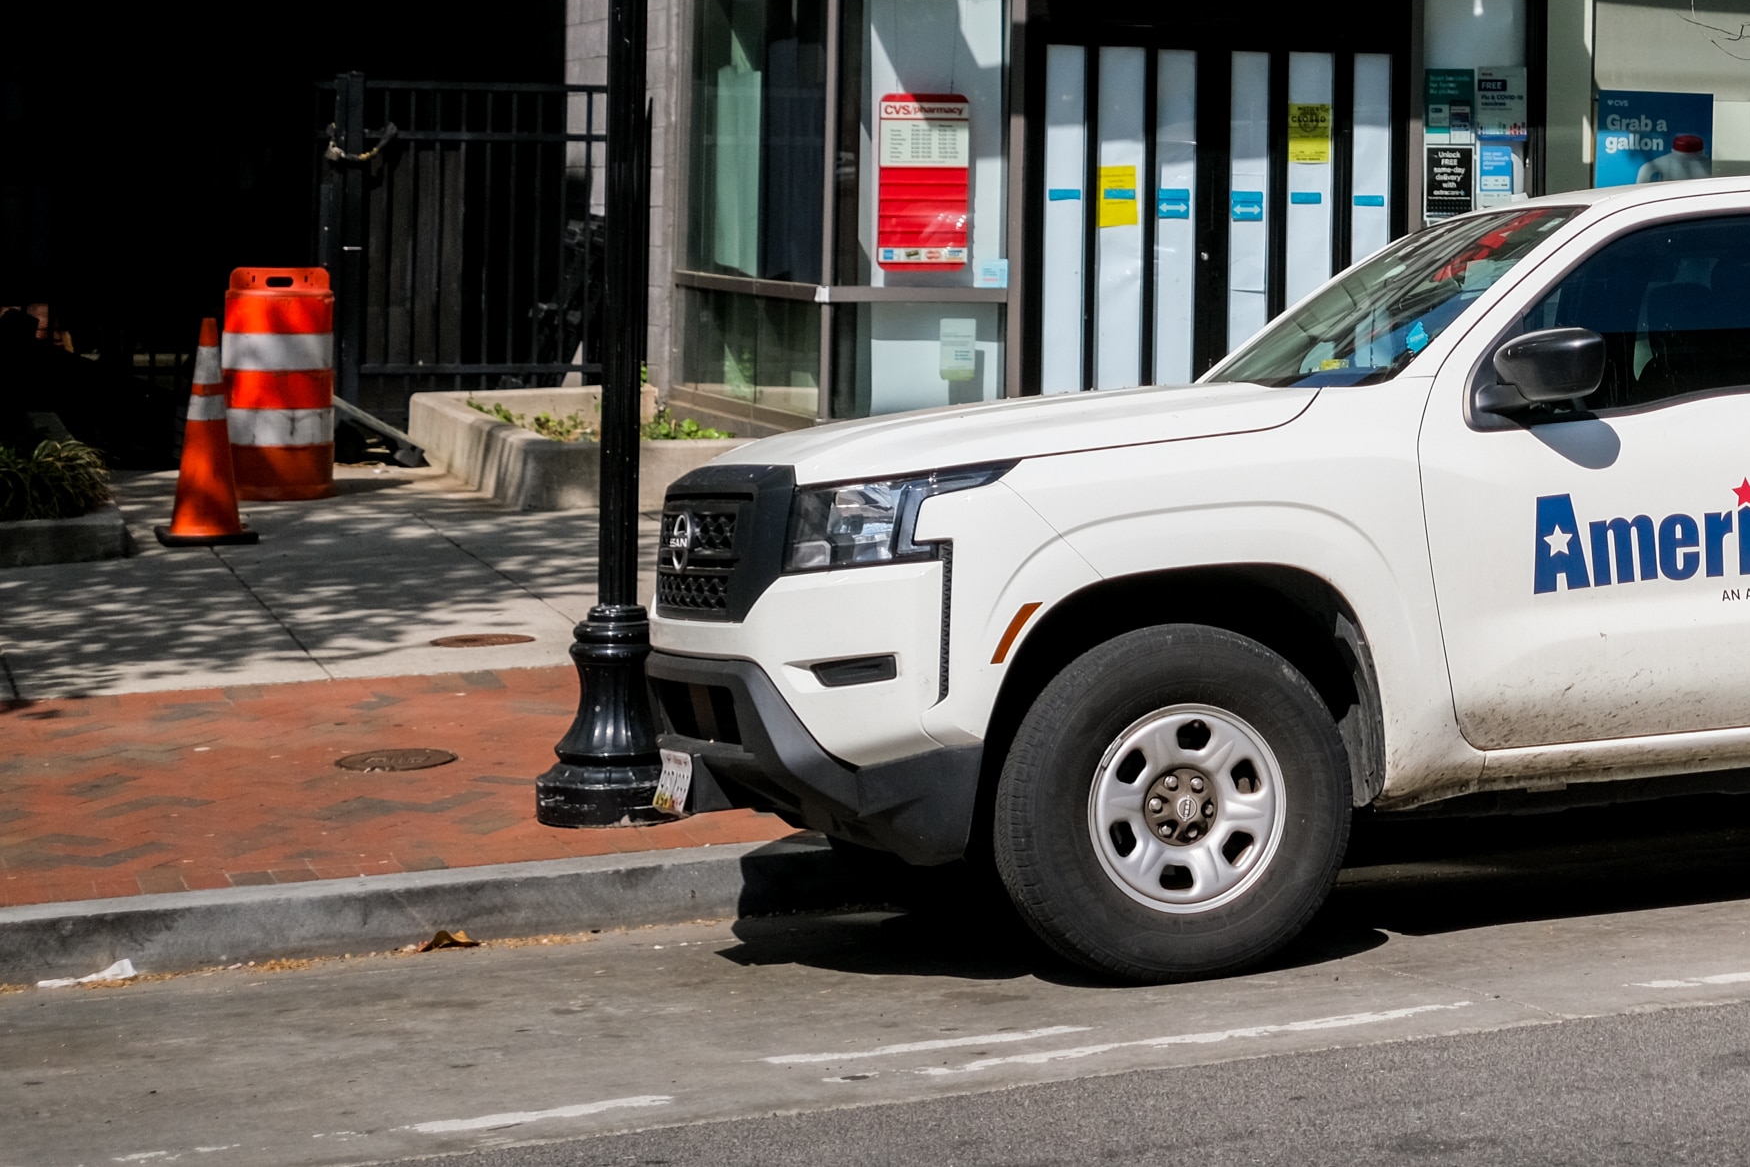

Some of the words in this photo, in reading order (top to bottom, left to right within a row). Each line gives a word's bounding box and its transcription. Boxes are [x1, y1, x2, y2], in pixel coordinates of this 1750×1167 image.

[1481, 81, 1503, 90] FREE
[1606, 113, 1653, 132] Grab
[1656, 119, 1668, 132] a
[1605, 133, 1664, 154] gallon
[1441, 158, 1458, 166] FREE
[1722, 588, 1741, 602] AN
